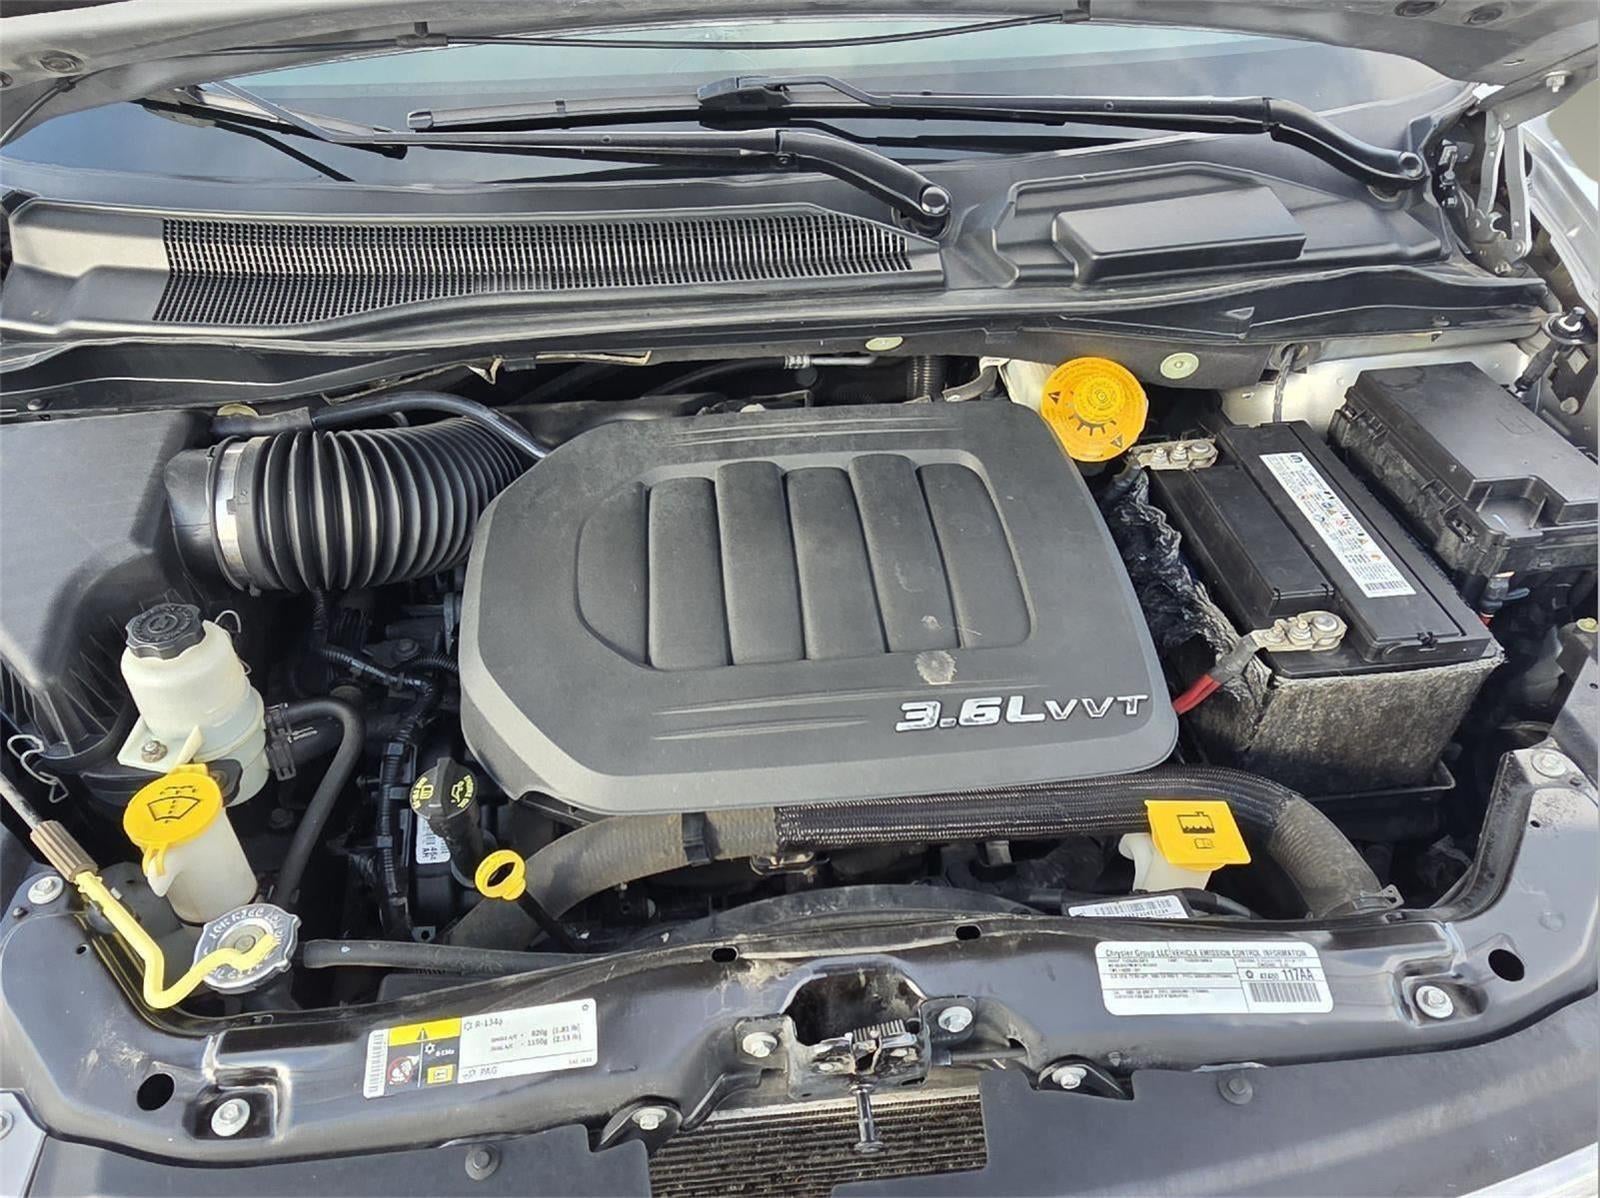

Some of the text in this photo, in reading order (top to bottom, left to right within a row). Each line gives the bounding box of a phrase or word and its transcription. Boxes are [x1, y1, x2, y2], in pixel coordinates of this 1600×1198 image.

[895, 695, 1045, 732] 3.6L
[1134, 949, 1155, 958] Group
[1172, 949, 1198, 957] VEHICLE
[1232, 949, 1260, 957] CONTROL
[1262, 949, 1307, 957] INFORMATION
[1282, 968, 1314, 981] 117AA
